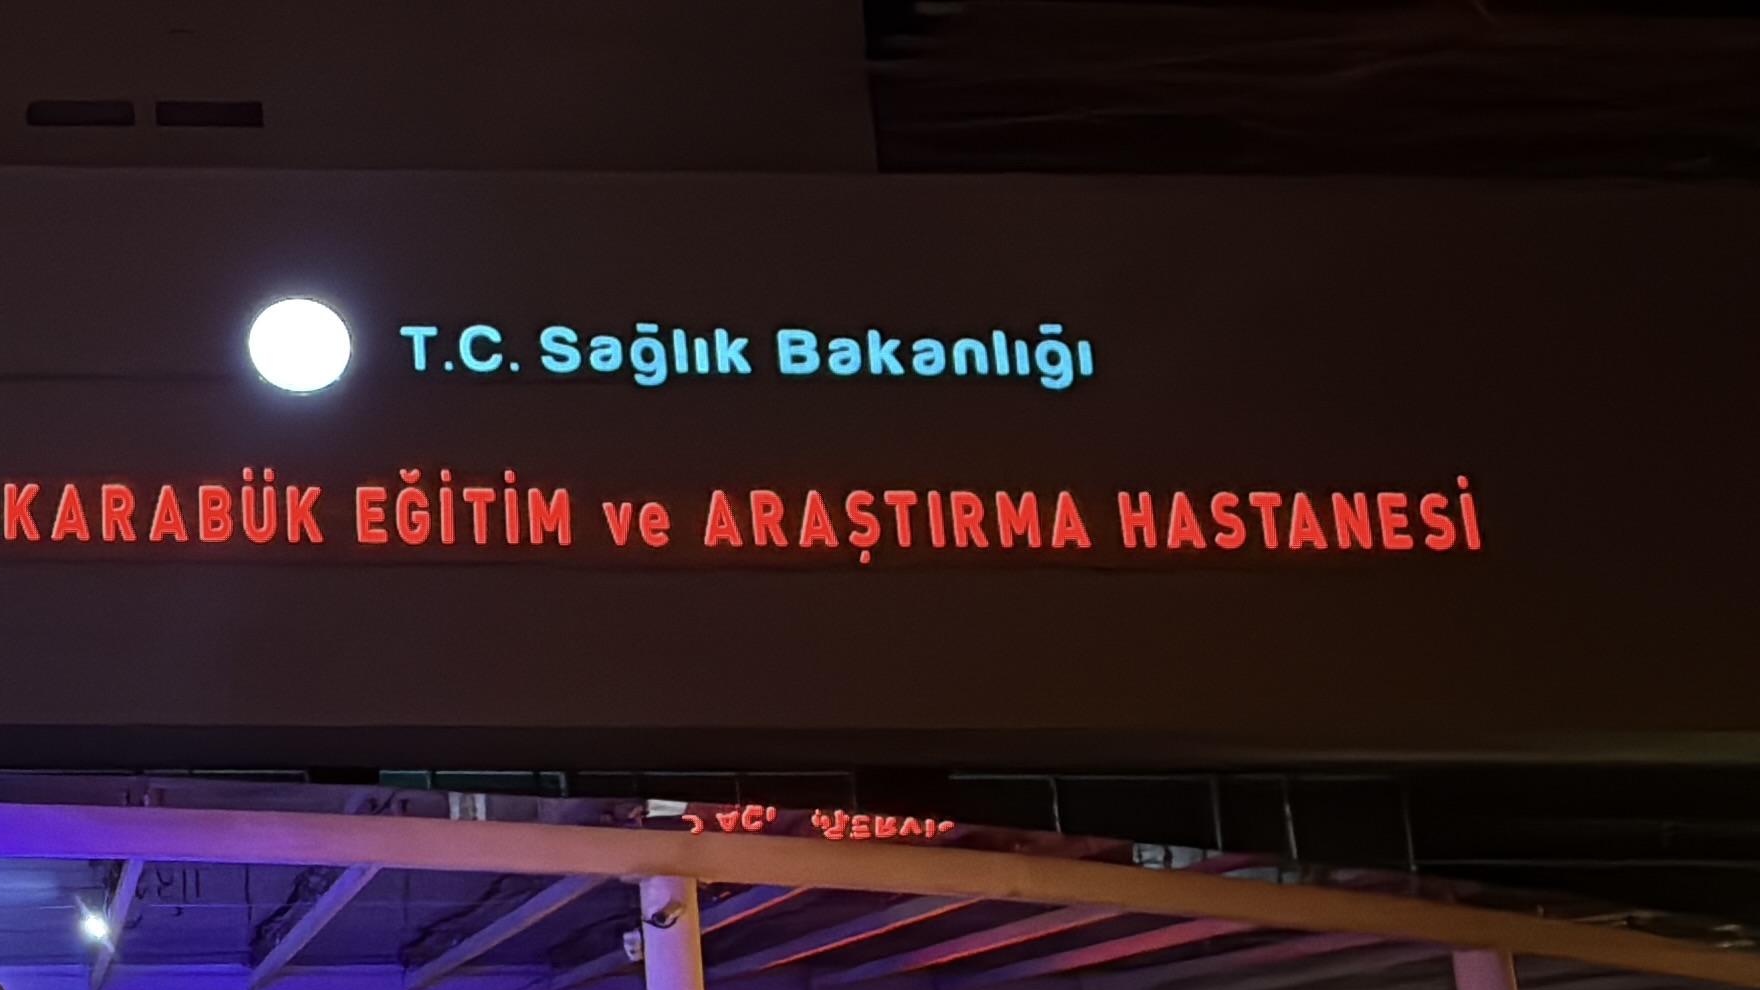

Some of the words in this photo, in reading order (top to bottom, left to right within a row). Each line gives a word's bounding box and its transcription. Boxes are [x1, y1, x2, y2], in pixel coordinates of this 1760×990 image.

[399, 324, 519, 372] T.C.
[539, 323, 751, 385] Sağlık
[776, 323, 1093, 389] Bakanlığı
[3, 467, 323, 543] KARABÜK
[355, 468, 571, 545] EĞİTİM
[601, 501, 671, 547] ve
[703, 489, 1091, 563] ARAŞTIRMA
[1117, 475, 1481, 550] HASTANESİ
